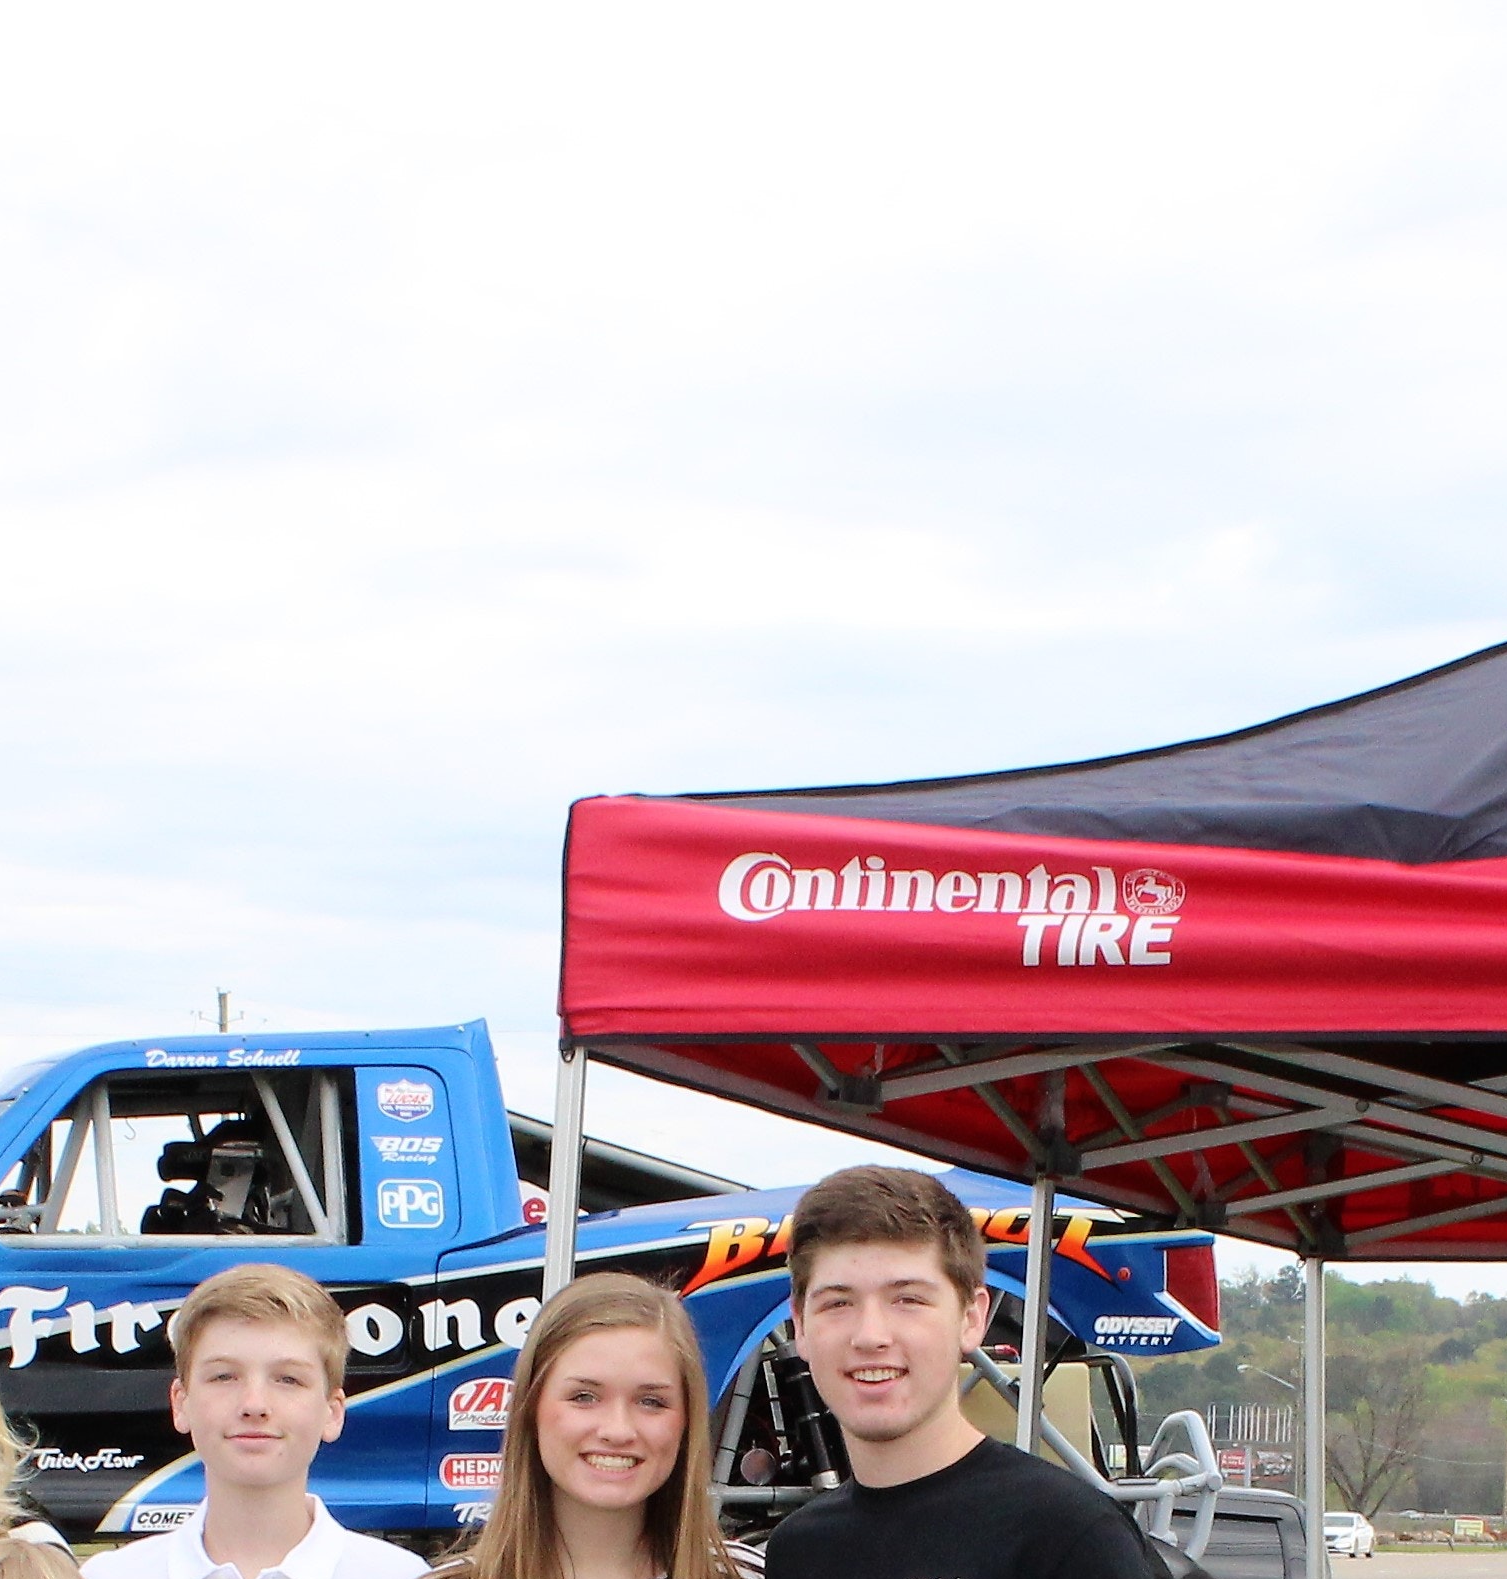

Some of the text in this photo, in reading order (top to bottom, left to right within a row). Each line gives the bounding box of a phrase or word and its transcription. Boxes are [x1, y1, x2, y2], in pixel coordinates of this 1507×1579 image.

[718, 852, 1118, 922] Continental
[1017, 914, 1181, 967] TIRE
[145, 1048, 301, 1067] Darron Schnell
[1093, 1315, 1180, 1335] ODYSSEY
[1095, 1336, 1172, 1346] BATTERY
[452, 1460, 503, 1474] HEDM
